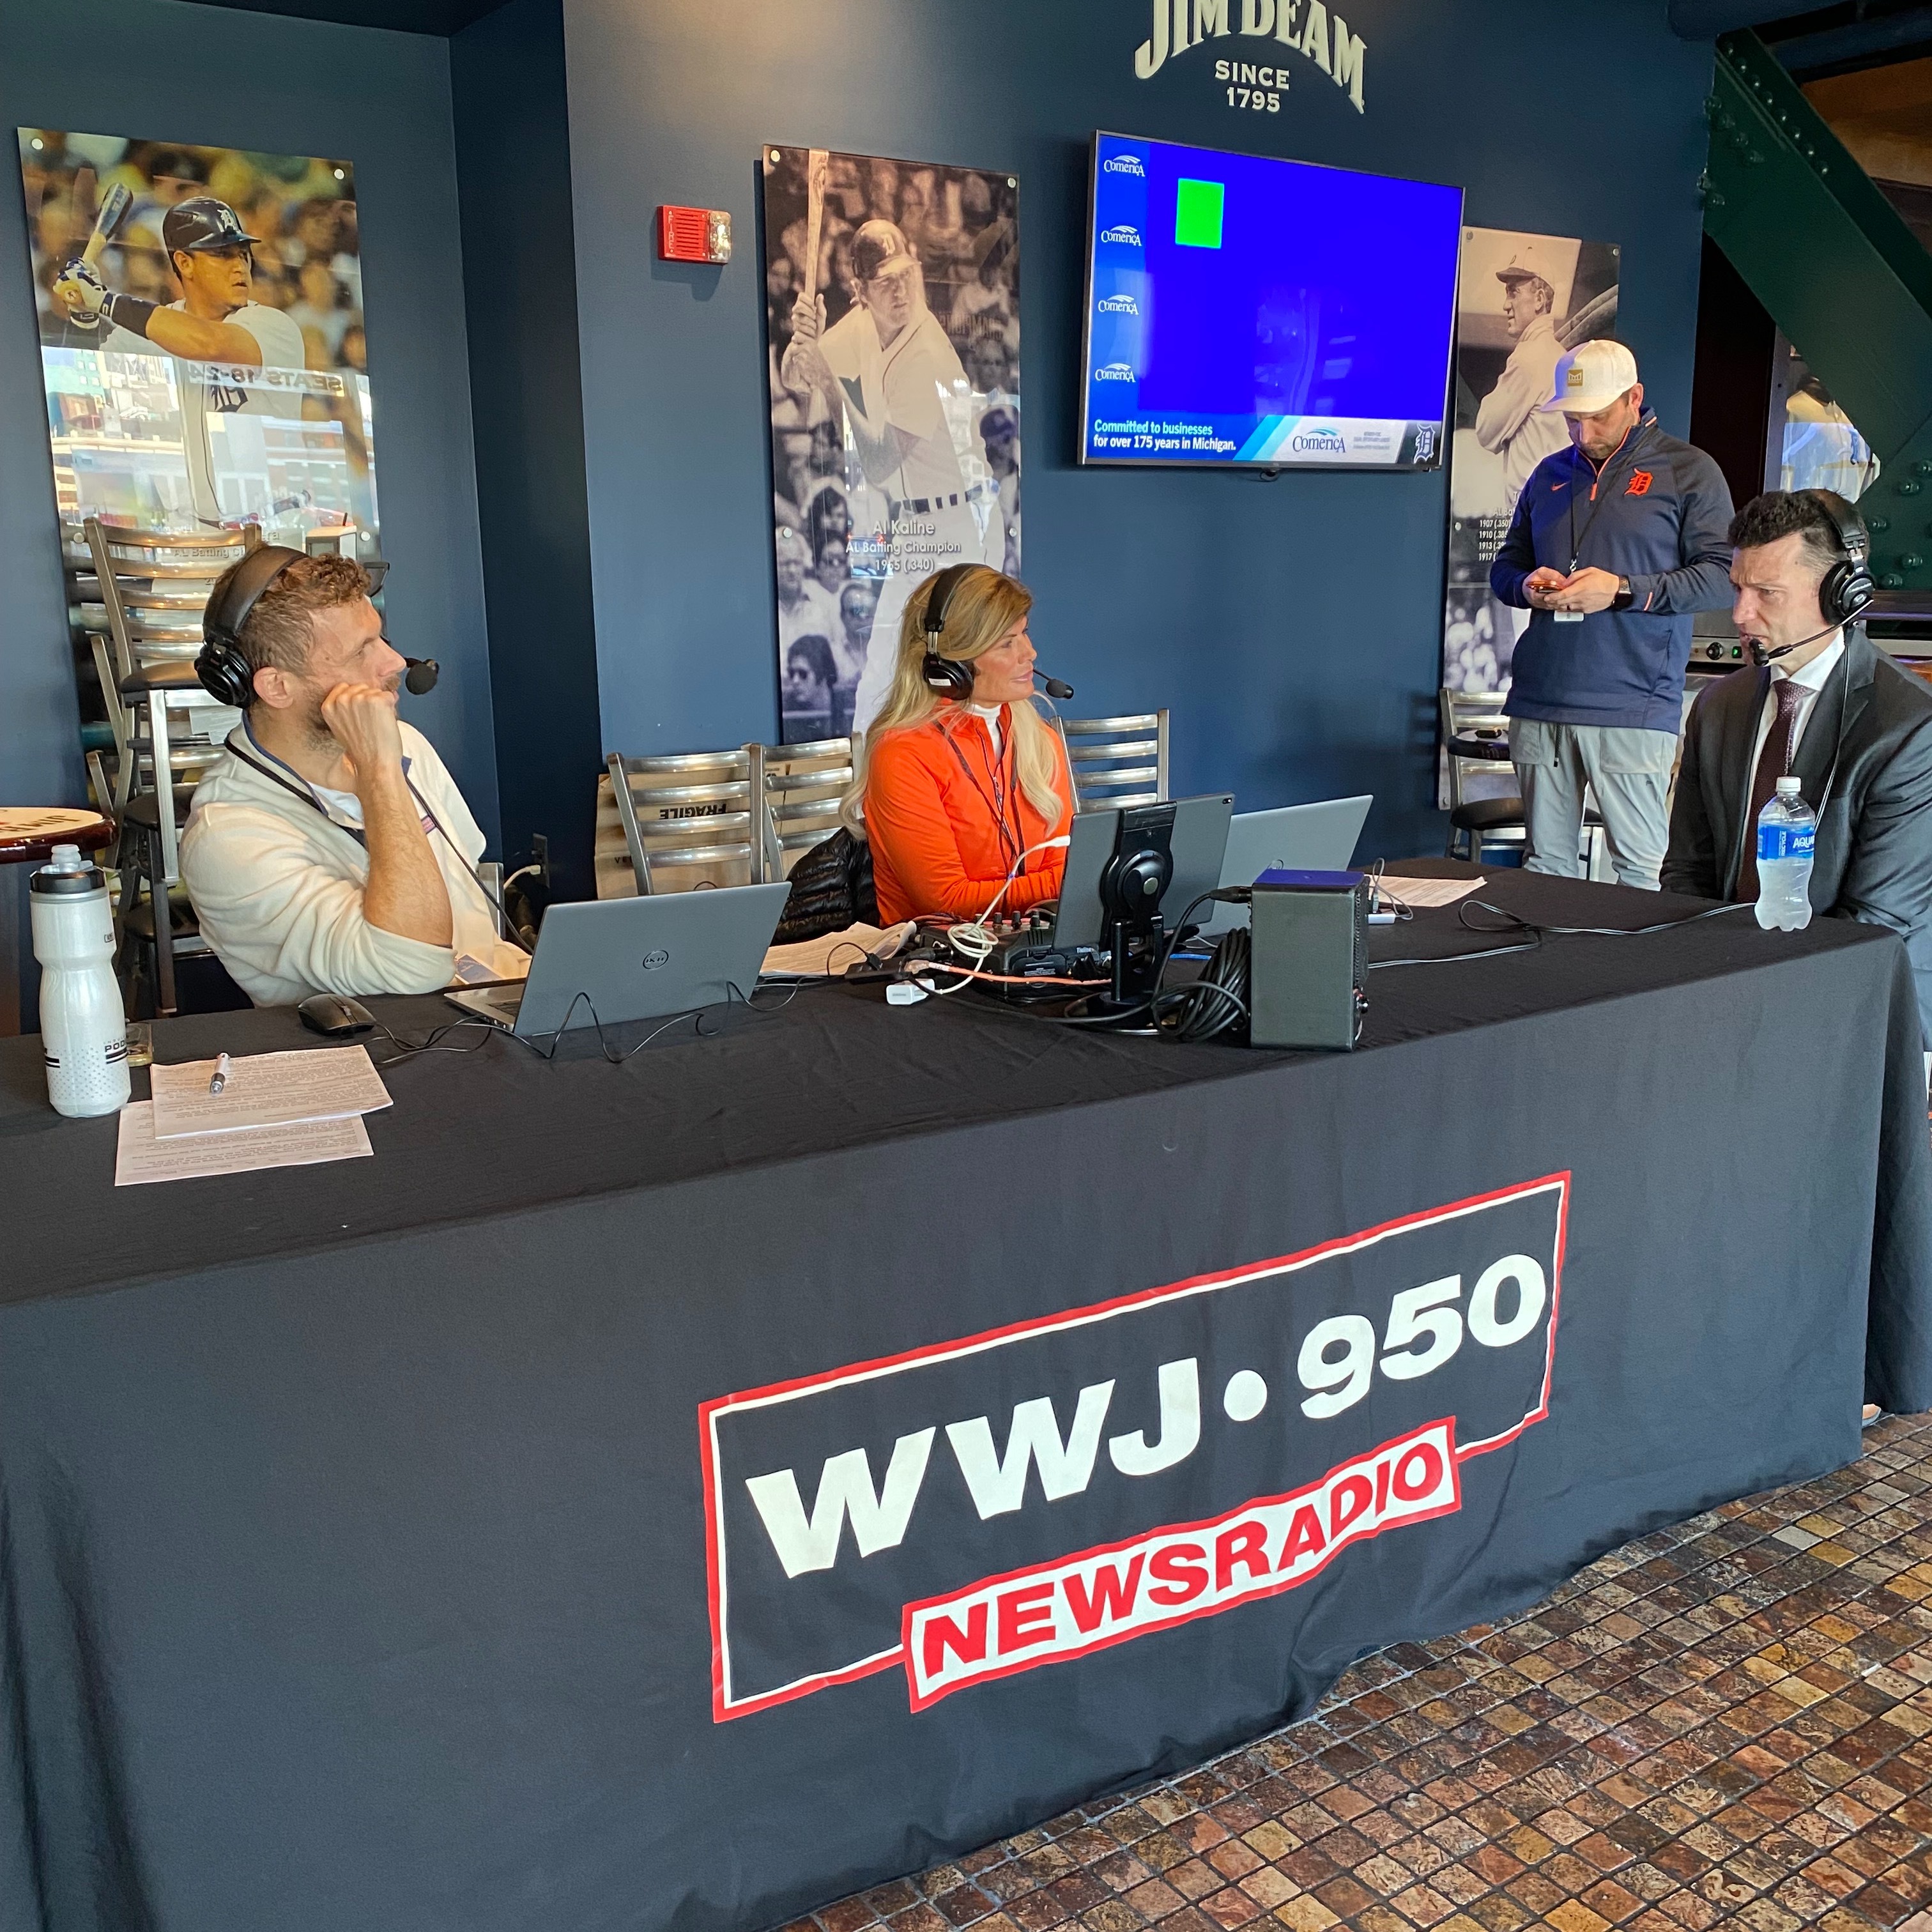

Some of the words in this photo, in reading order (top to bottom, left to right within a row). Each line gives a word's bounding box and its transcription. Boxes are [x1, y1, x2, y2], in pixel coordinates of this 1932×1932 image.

[1215, 59, 1290, 90] SINCE
[1227, 86, 1280, 112] 1795
[1094, 419, 1149, 433] Committed
[1150, 421, 1160, 434] to
[1162, 422, 1213, 435] businesses
[1093, 434, 1108, 447] for
[1110, 437, 1131, 448] over
[1133, 435, 1153, 448] 175
[1154, 439, 1180, 452] years
[1181, 437, 1192, 449] in
[1192, 437, 1236, 452] Michigan.
[873, 519, 887, 535] Al
[891, 519, 936, 535] Kaline
[1480, 519, 1493, 528] 1907
[1479, 530, 1493, 539] 1910
[1493, 530, 1508, 540] (.385
[845, 541, 860, 553] AL
[862, 541, 901, 555] Batting
[903, 541, 961, 555] Champion
[1478, 541, 1492, 550] 1913
[1493, 541, 1506, 551] (.39
[1478, 552, 1492, 562] 1917
[903, 559, 935, 574] (.340)
[659, 803, 727, 820] FRAGILE
[105, 1039, 125, 1053] POD
[745, 1357, 1200, 1579] WWJ
[1297, 1254, 1547, 1419] 950
[921, 1440, 1445, 1680] NEWSRADIO
